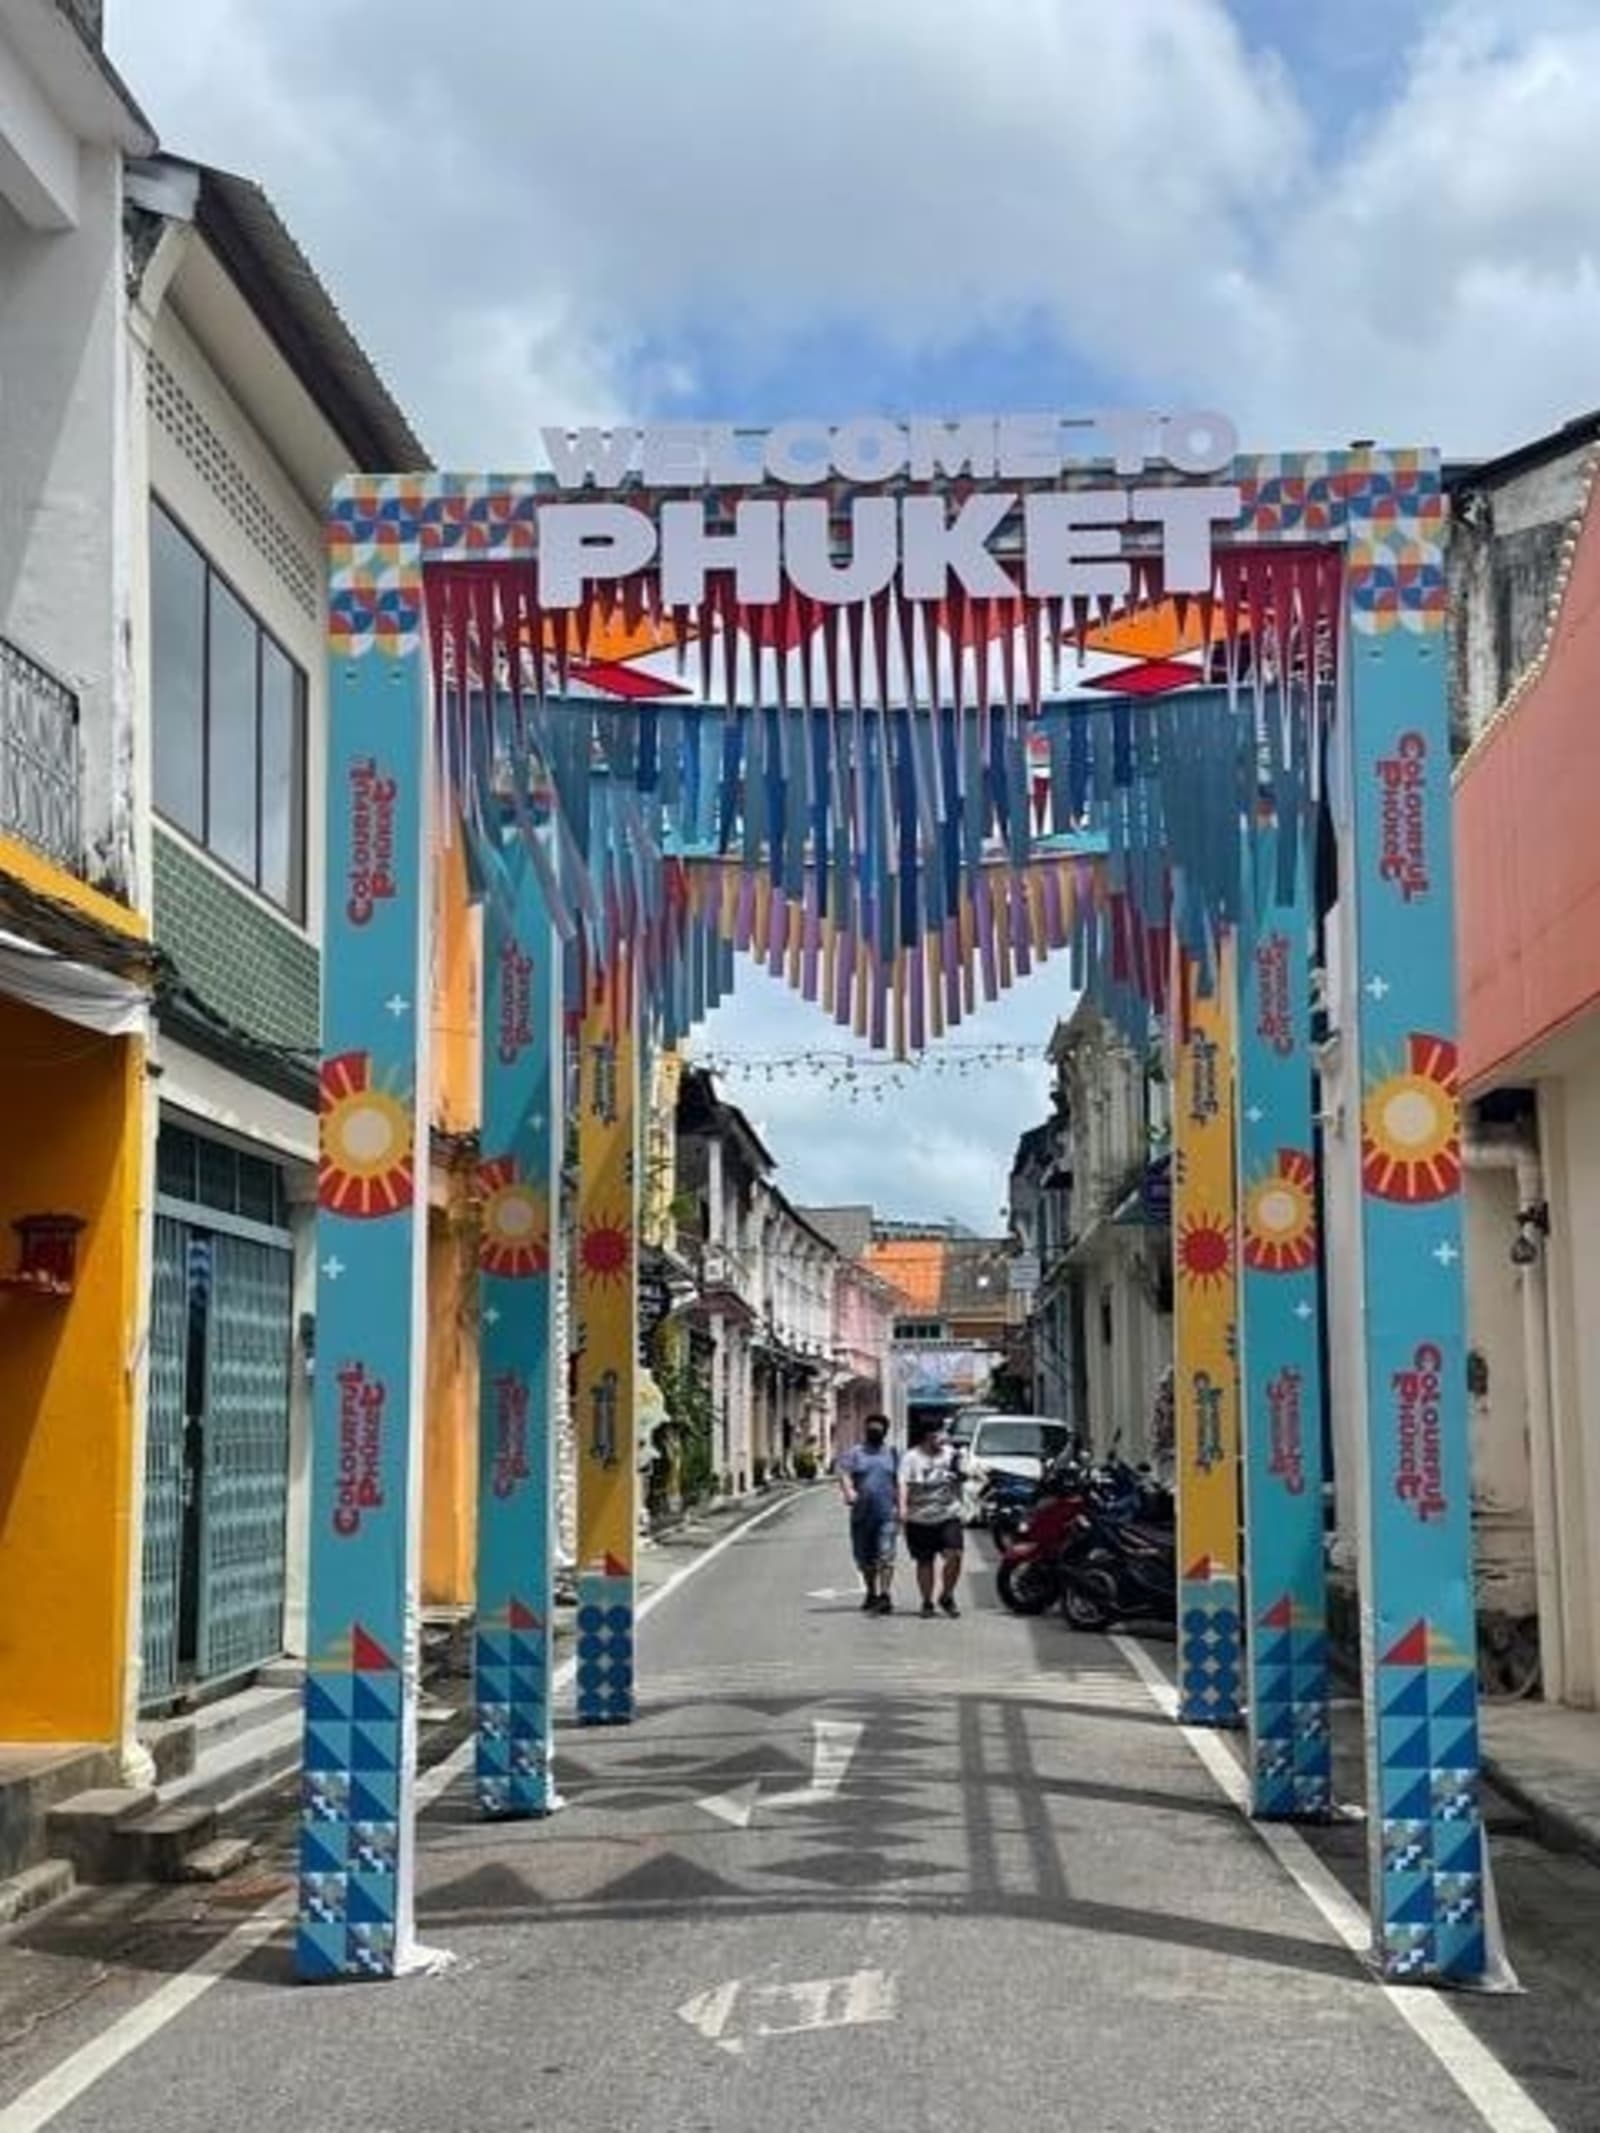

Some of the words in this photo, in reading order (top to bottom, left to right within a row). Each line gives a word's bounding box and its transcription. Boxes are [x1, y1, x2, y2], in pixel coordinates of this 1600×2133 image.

[540, 416, 1059, 489] WELCOME
[1097, 409, 1240, 474] TO
[537, 486, 1241, 608] PHUKET
